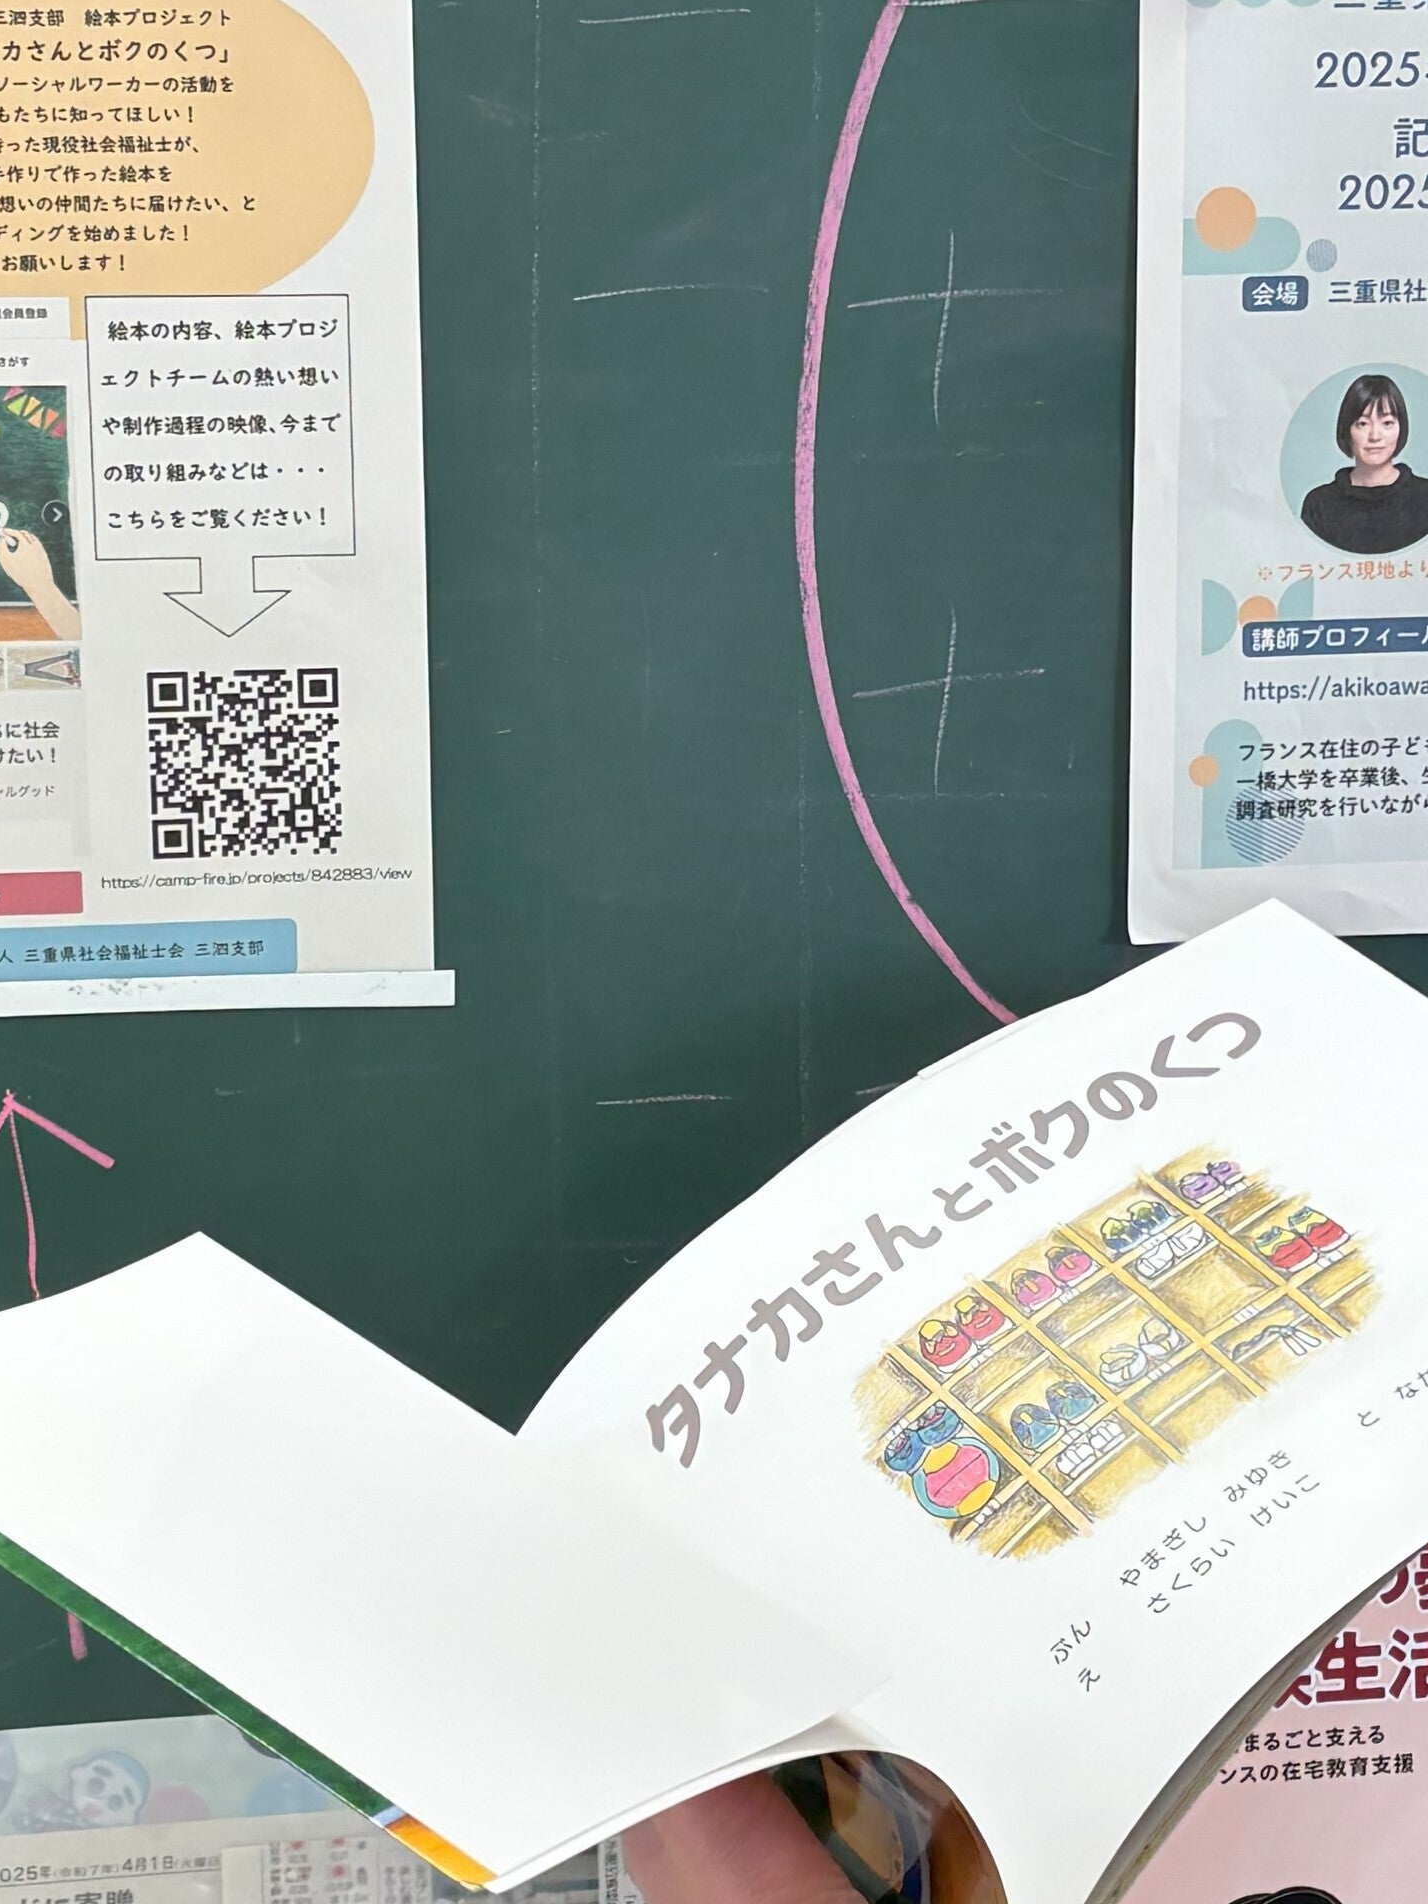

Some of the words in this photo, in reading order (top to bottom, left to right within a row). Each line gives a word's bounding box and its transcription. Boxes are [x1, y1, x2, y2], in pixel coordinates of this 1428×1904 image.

[84, 8, 232, 27] 絵本プロジェクト
[1251, 281, 1299, 306] 会場
[101, 366, 339, 388] ェクトチームの熱い想い
[102, 413, 341, 436] や制作過程の映像、今まで
[107, 506, 327, 530] こちらをご覧ください！
[101, 866, 412, 891] https://camp-fire.jp/projects/842883/view
[24, 941, 185, 965] 三重県社会福祉士会
[195, 939, 265, 960] 三泗支部
[645, 1011, 1263, 1473] タナカさんとボクのくつ
[1356, 1408, 1381, 1429] と
[1049, 1620, 1091, 1665] ぶん
[1224, 1449, 1292, 1504] みゆき
[1078, 1668, 1101, 1693] え
[1147, 1539, 1236, 1614] さくらい
[1251, 1472, 1321, 1528] けいこ
[1220, 1752, 1414, 1785] ンスの在宅教育支援
